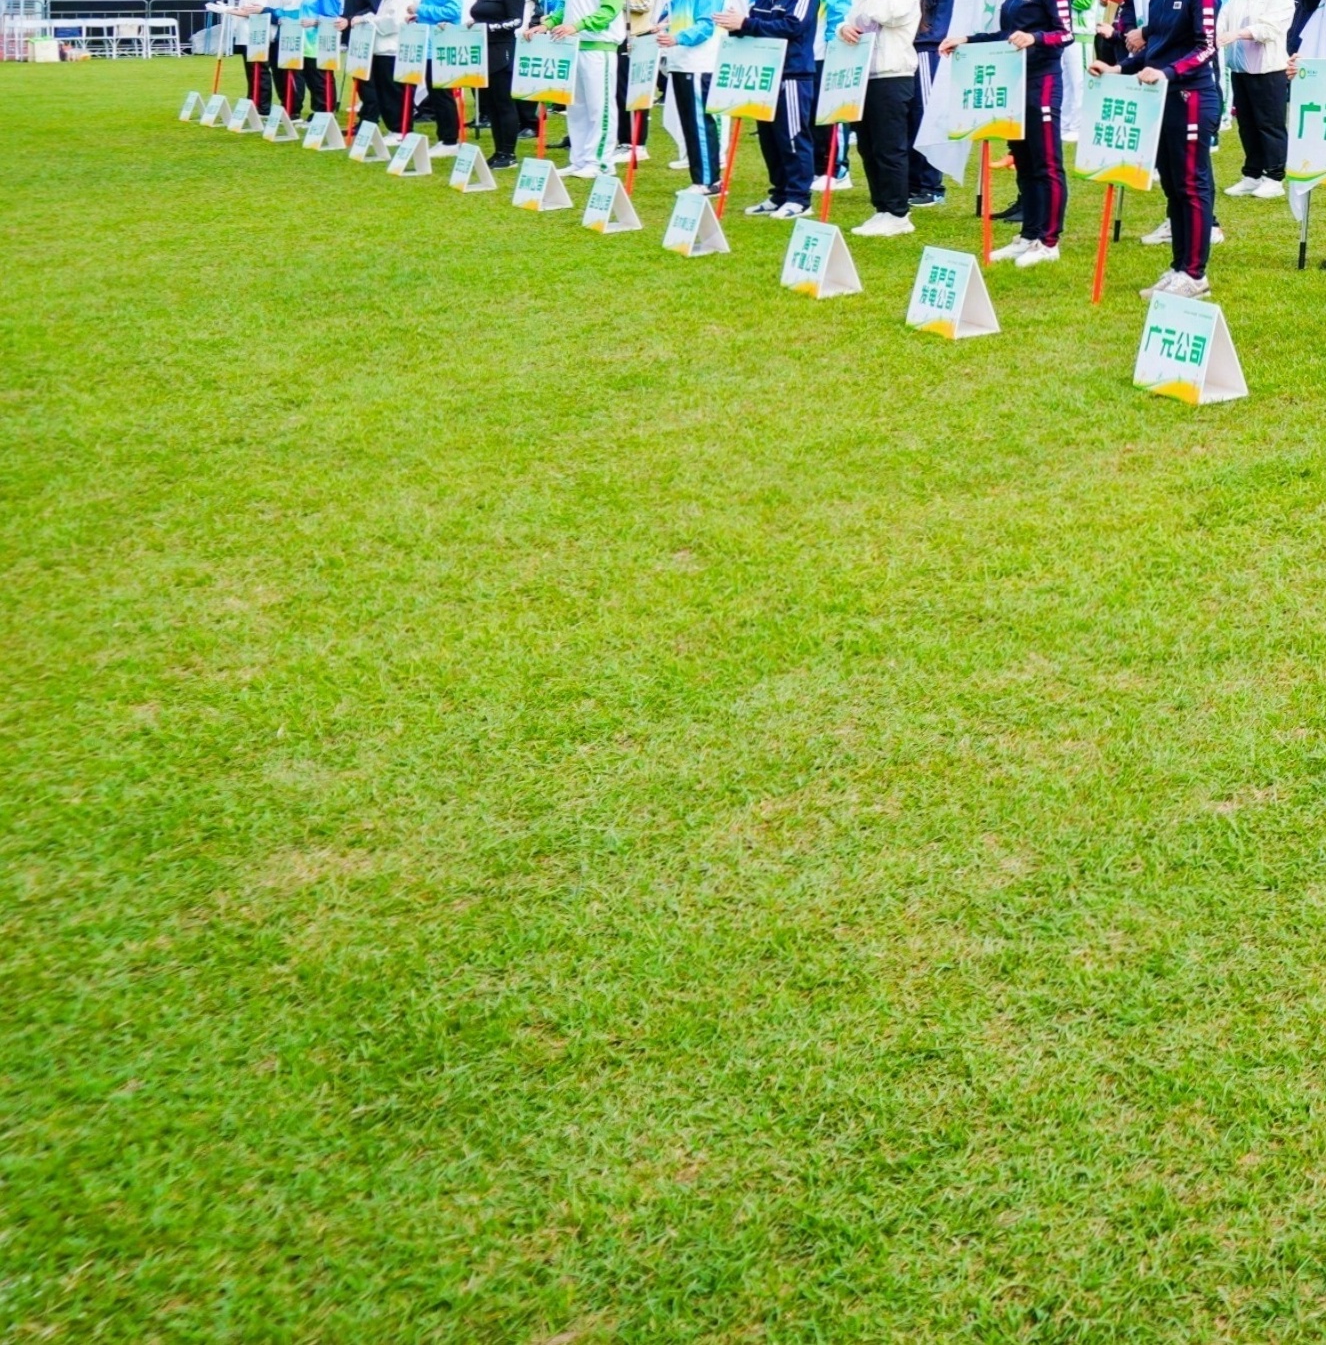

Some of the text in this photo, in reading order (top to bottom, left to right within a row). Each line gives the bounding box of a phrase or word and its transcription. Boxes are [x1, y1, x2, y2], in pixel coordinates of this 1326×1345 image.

[436, 44, 482, 66] 平阳公司
[518, 55, 571, 81] 密云公司
[716, 62, 776, 93] 金沙公司
[1101, 97, 1138, 125] 葫芦岛
[1092, 122, 1142, 153] 发电公司
[928, 265, 957, 289] 葫芦岛
[919, 284, 957, 312] 发电公司
[1146, 324, 1208, 366] 广元公司
